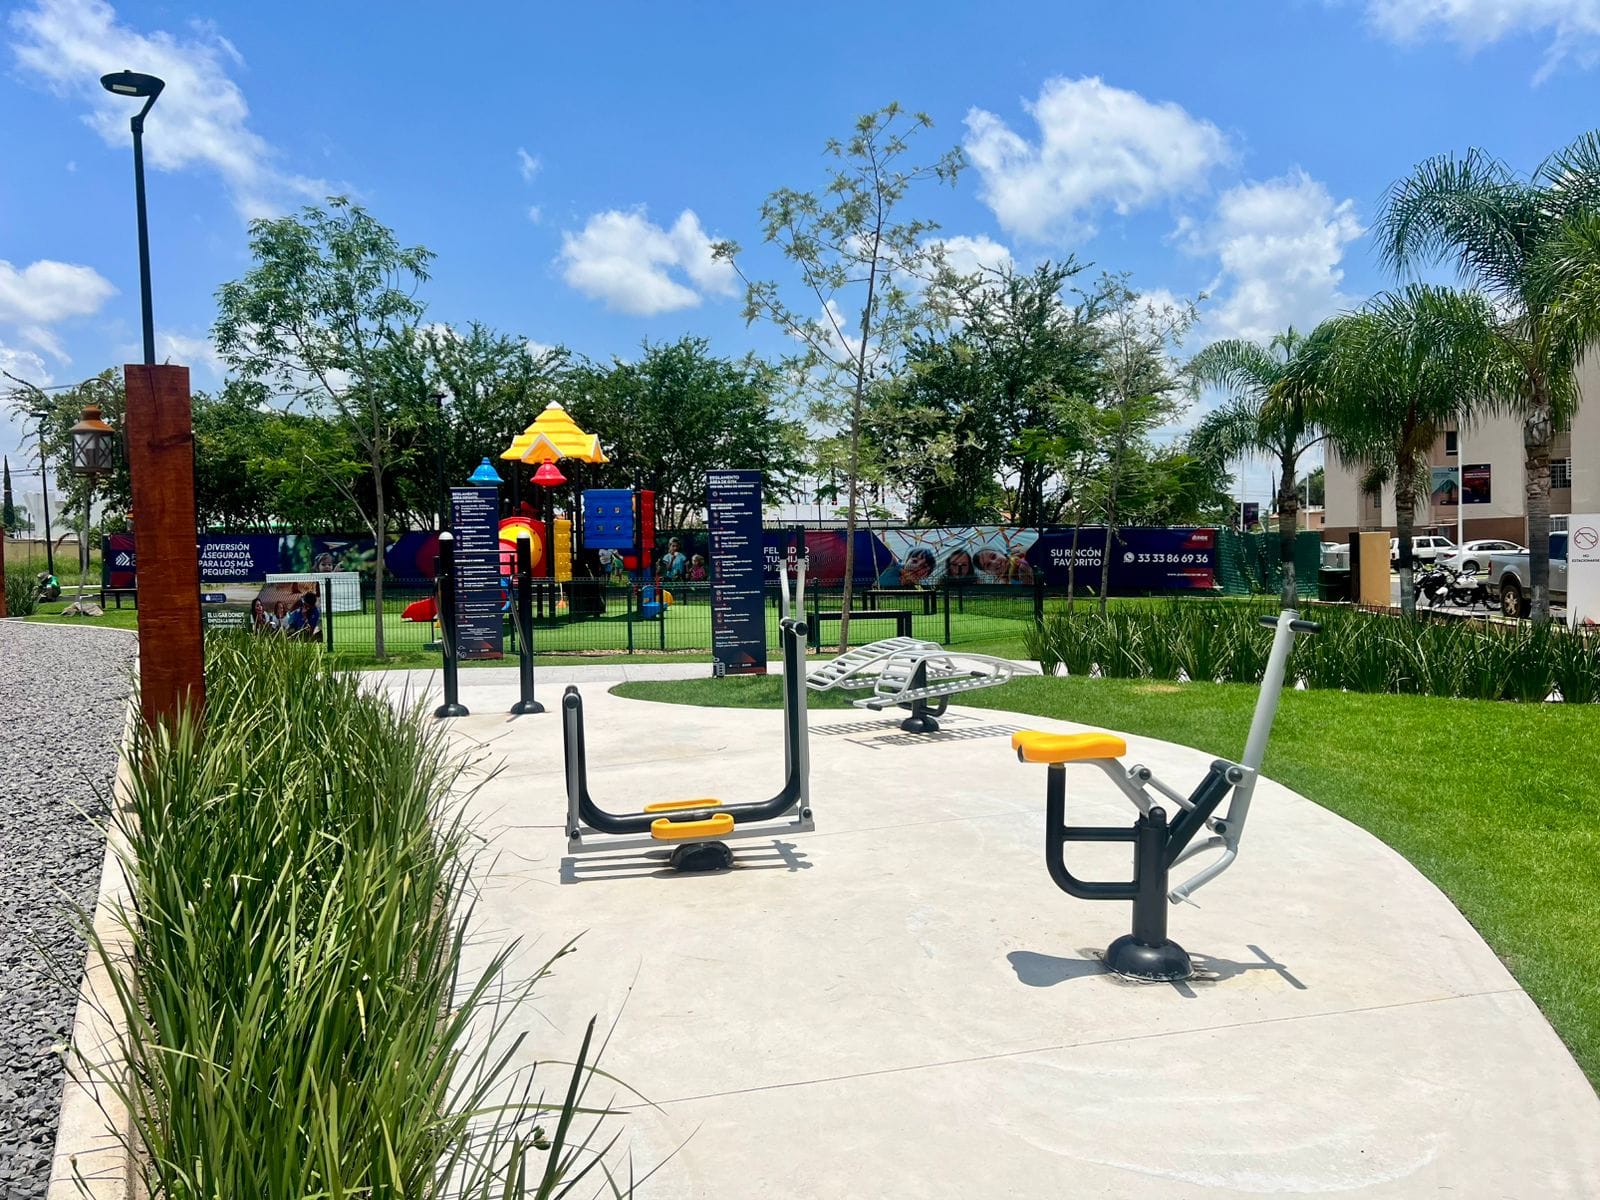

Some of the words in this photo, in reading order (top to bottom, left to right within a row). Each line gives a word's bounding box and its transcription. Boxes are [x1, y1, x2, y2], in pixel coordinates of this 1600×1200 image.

[201, 551, 251, 559] ASEGURADA
[1050, 548, 1063, 557] SU
[1064, 546, 1102, 557] RINCÓN
[236, 558, 254, 567] MÁS
[1053, 558, 1102, 567] FAVORITO
[1137, 553, 1151, 563] 33
[1152, 553, 1165, 563] 33
[1166, 553, 1180, 563] 86
[1180, 553, 1194, 563] 69
[1195, 553, 1209, 563] 36
[202, 566, 249, 576] PEQUEÑOS!
